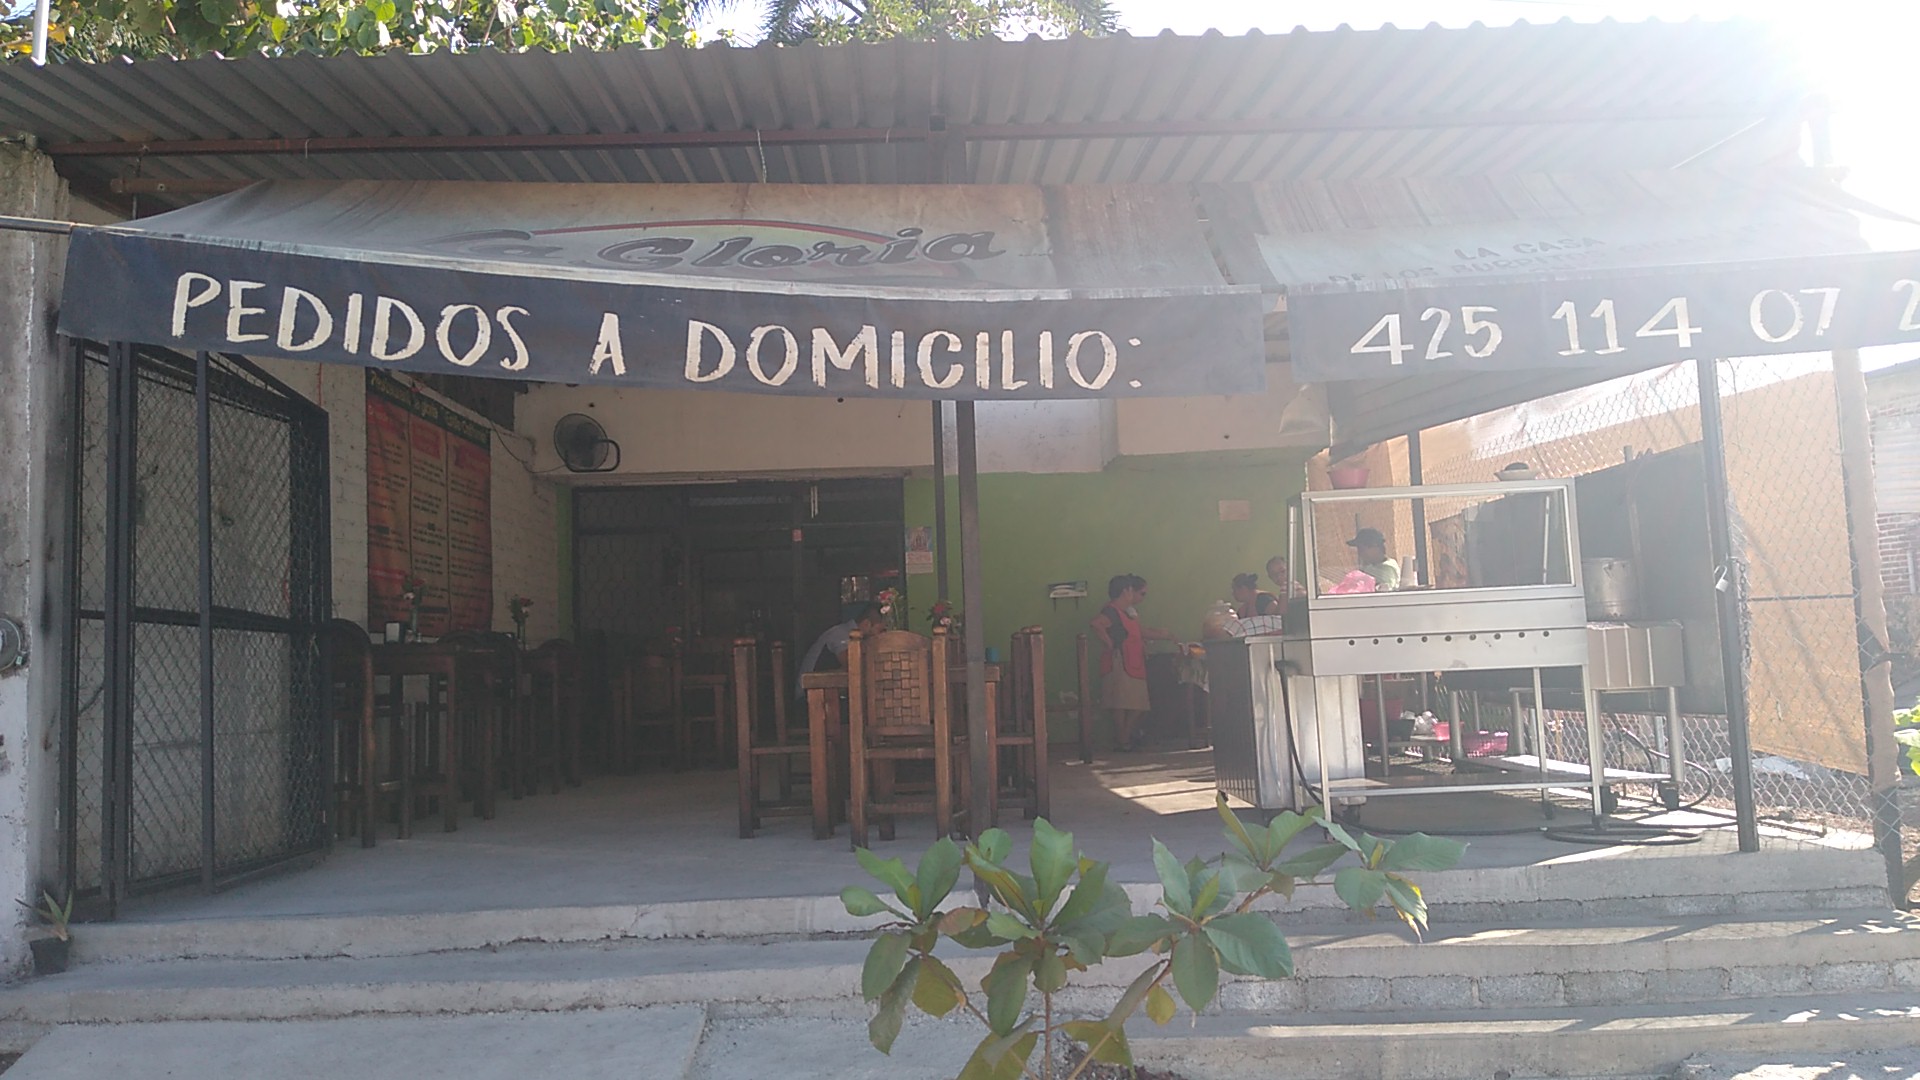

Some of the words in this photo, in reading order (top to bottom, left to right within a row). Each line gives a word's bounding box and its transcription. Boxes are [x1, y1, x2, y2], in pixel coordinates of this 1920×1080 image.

[597, 228, 1007, 270] Gloria
[1455, 247, 1501, 260] LA
[1513, 237, 1606, 255] CASA
[172, 272, 530, 372] PEDIDOS
[590, 312, 627, 376] A
[685, 319, 1142, 391] DOMICILIO:
[1350, 306, 1503, 366] 425
[1552, 297, 1702, 356] 114
[1750, 288, 1841, 343] 07
